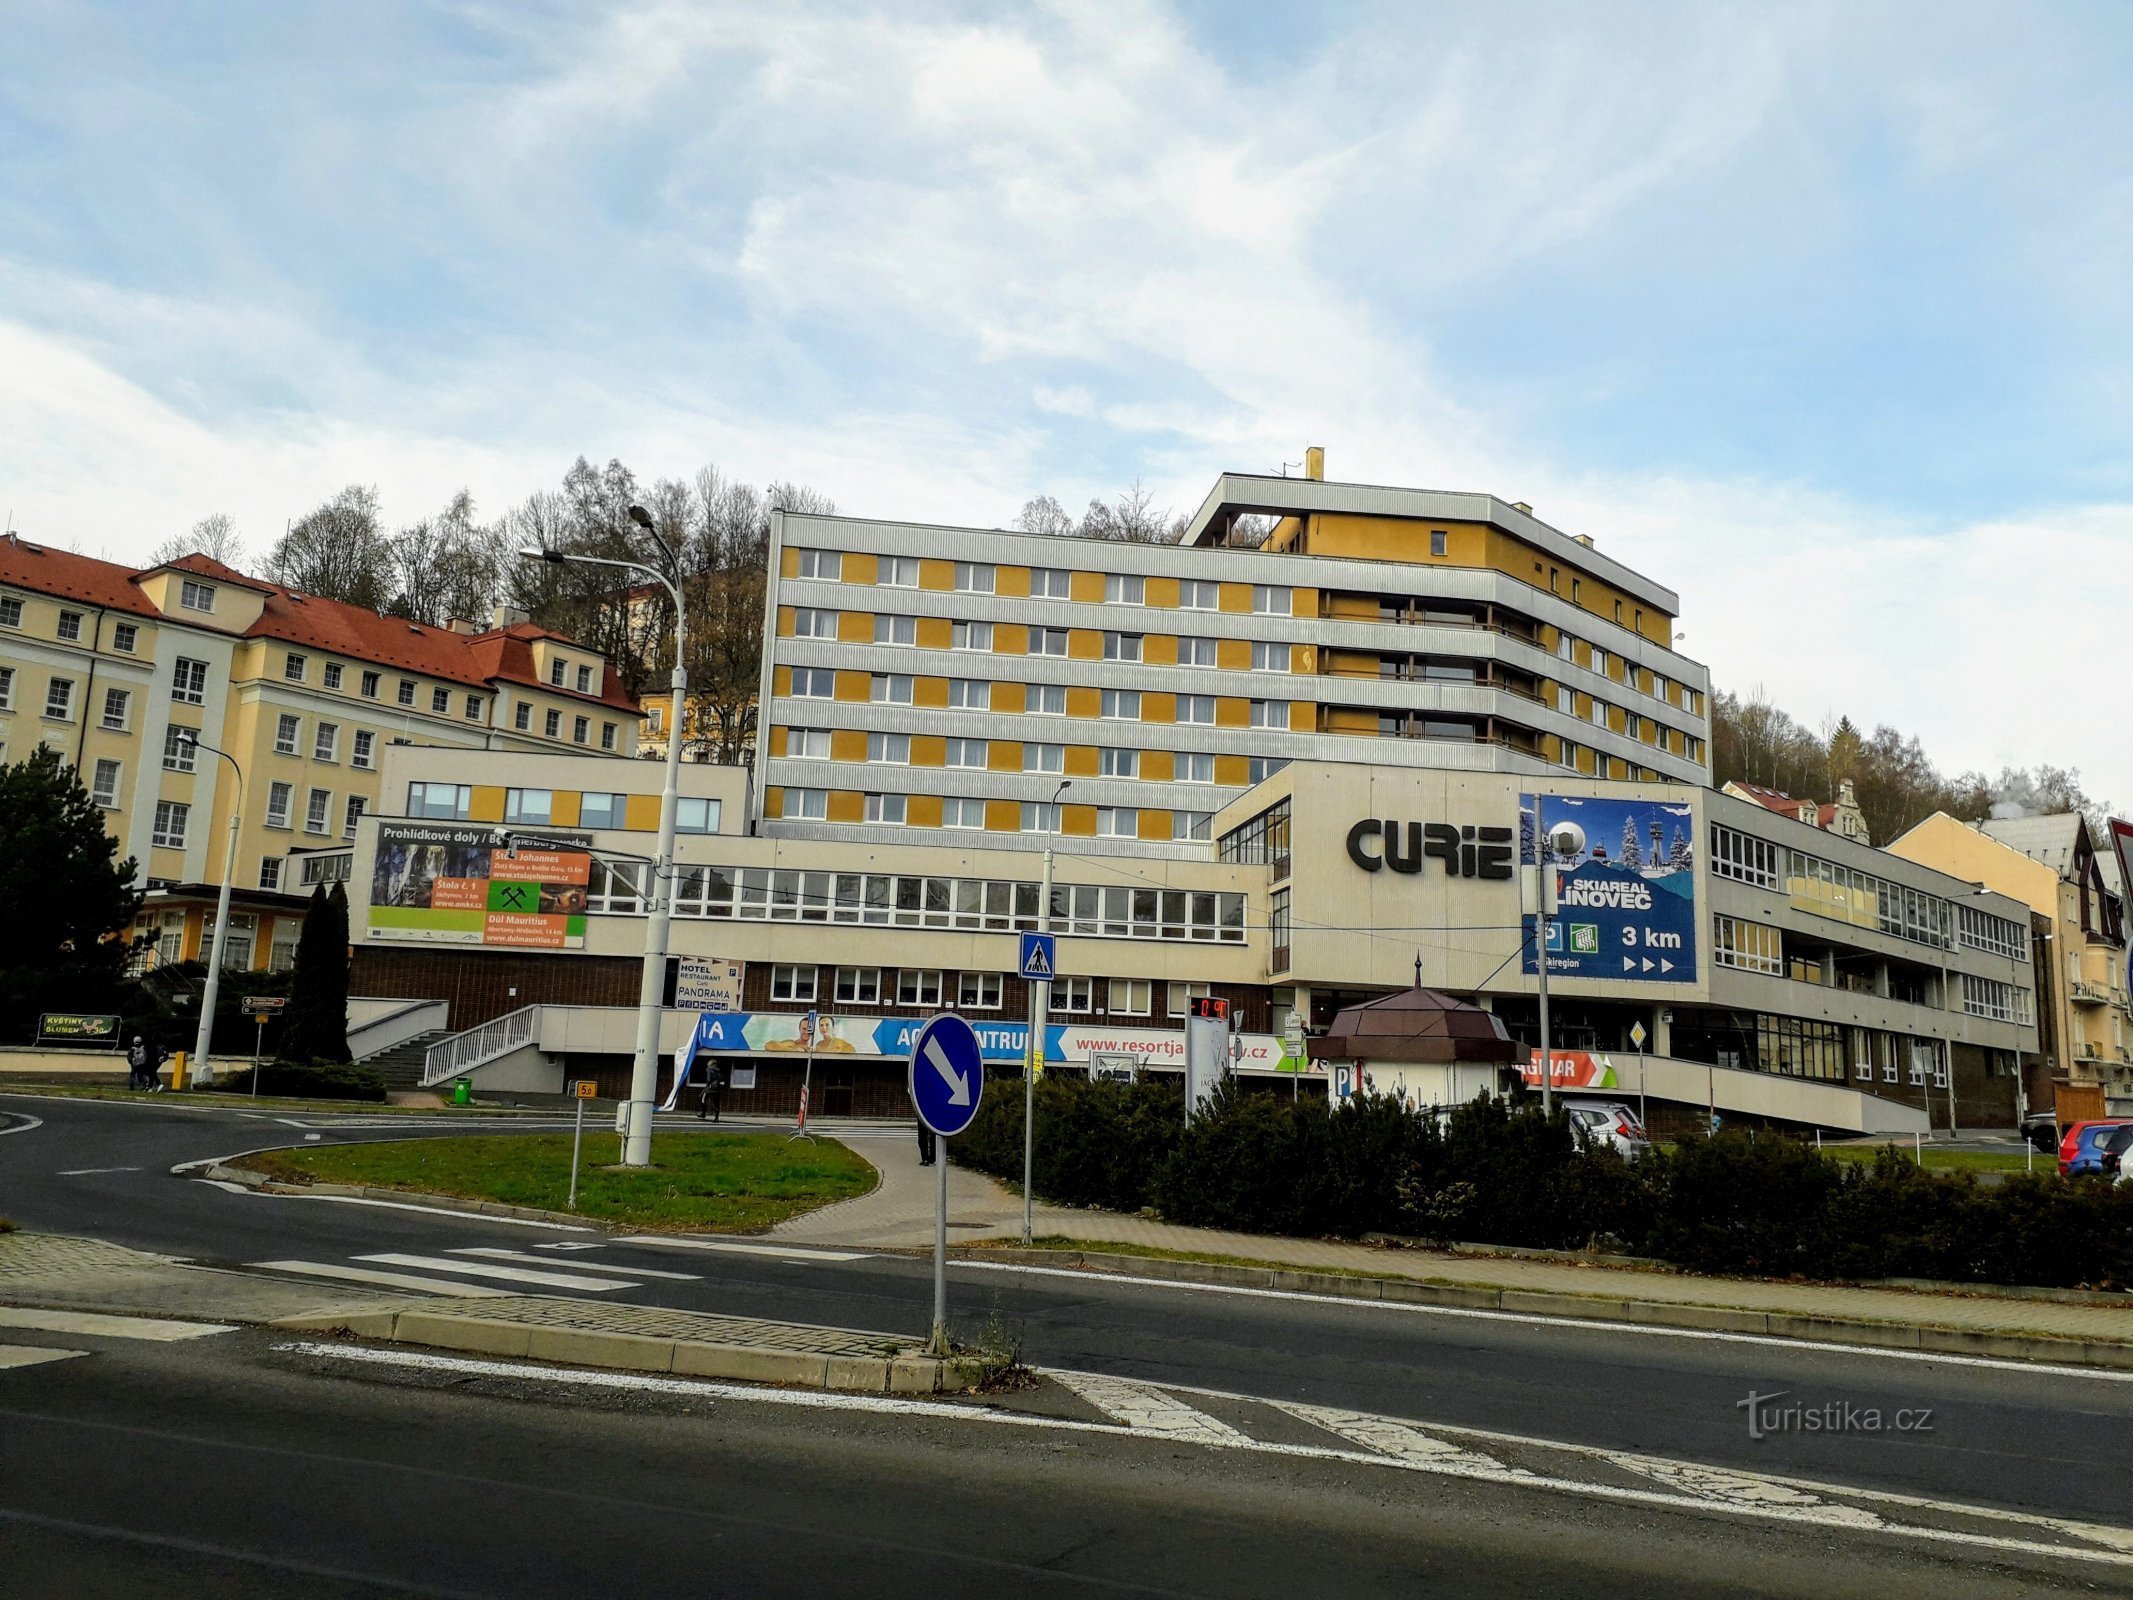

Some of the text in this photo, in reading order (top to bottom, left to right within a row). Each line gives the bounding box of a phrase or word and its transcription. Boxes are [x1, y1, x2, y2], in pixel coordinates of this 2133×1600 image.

[384, 827, 450, 841] Prohlídkové
[454, 831, 479, 845] doly
[1346, 819, 1512, 879] CURIE
[520, 853, 559, 863] Johannes
[437, 880, 459, 889] Štola
[472, 882, 476, 890] 1
[1573, 879, 1649, 894] SKIAREAL
[488, 914, 547, 925] Důl Mauritius
[1622, 926, 1637, 946] 3
[1645, 926, 1681, 948] km
[681, 965, 711, 973] HOTEL
[680, 973, 721, 981] RESTAURANT
[679, 986, 730, 999] PANORAMA
